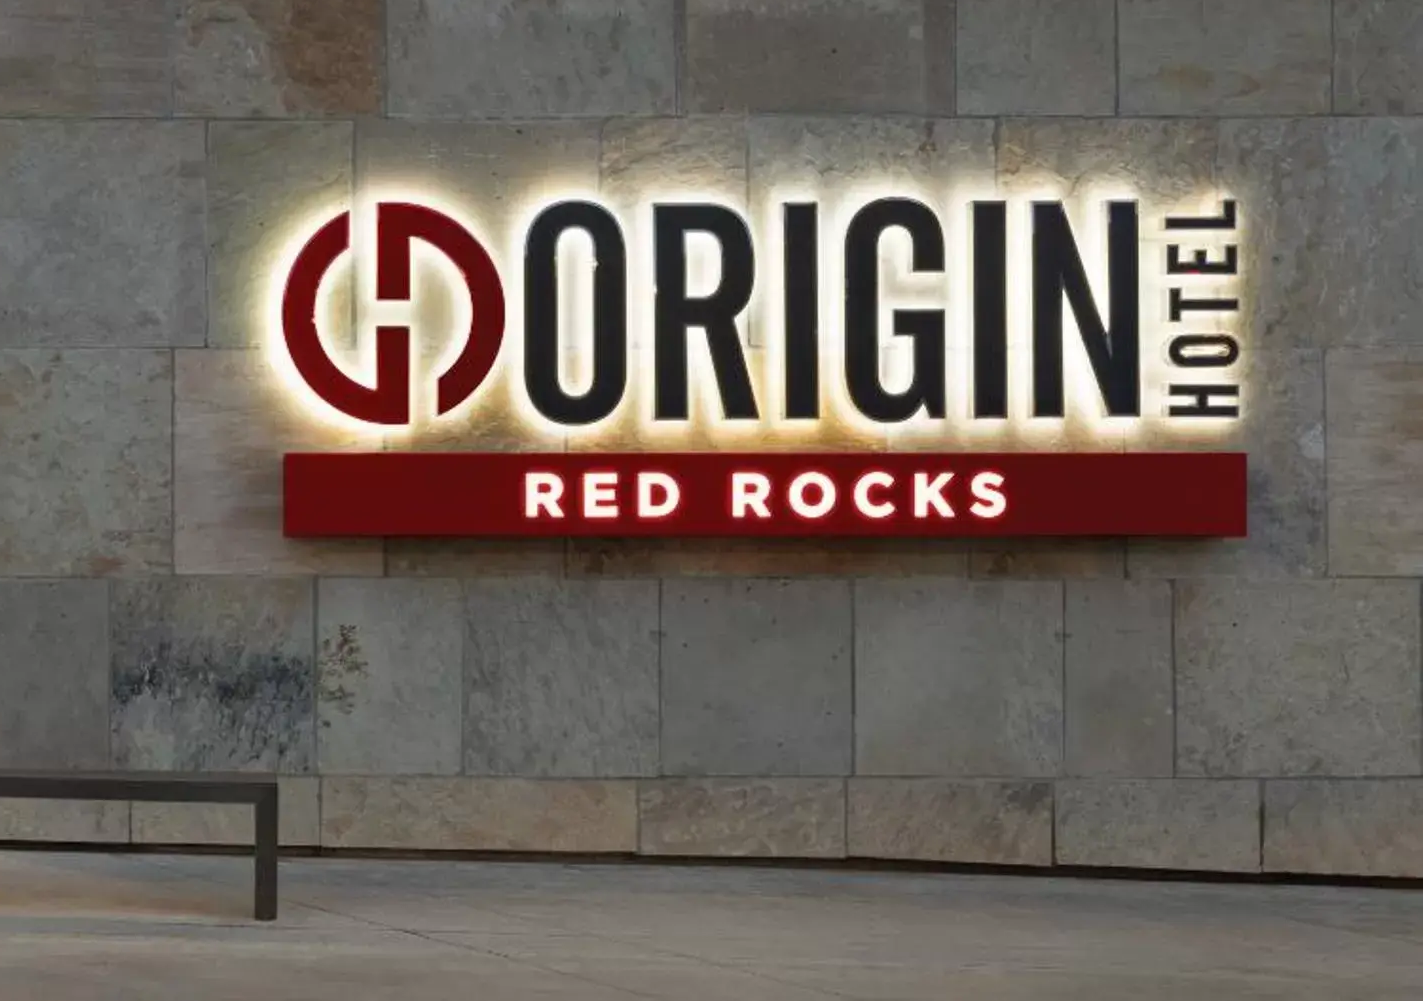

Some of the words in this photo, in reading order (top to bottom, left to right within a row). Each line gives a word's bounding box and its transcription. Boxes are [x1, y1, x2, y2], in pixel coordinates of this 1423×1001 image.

[523, 197, 1141, 426] ORIGIN
[1165, 199, 1240, 418] HOTEL
[524, 471, 681, 519] RED
[731, 470, 1009, 520] ROCKS
